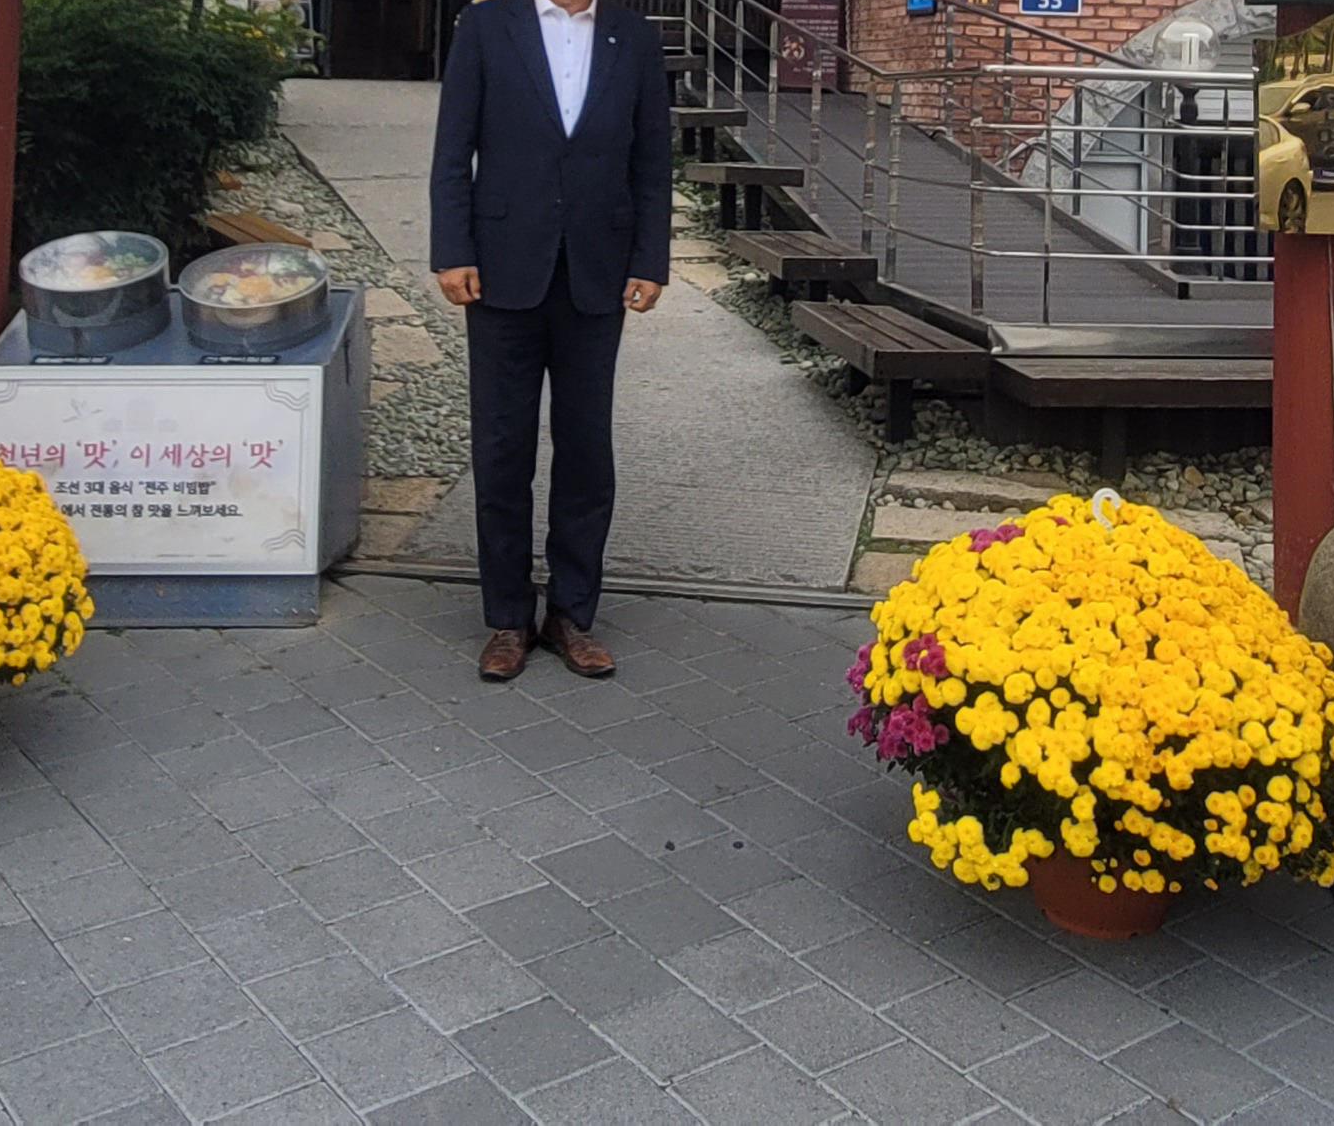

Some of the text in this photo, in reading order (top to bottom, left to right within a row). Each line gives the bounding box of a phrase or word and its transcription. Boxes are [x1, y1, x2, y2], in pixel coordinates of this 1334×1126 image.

[130, 443, 151, 468] 이
[159, 443, 232, 468] 세상의
[54, 481, 80, 495] 조선
[84, 481, 105, 494] 3대
[109, 481, 133, 495] 음식
[90, 504, 127, 518] 전통의
[131, 504, 143, 518] 참
[148, 504, 172, 518] 맛을
